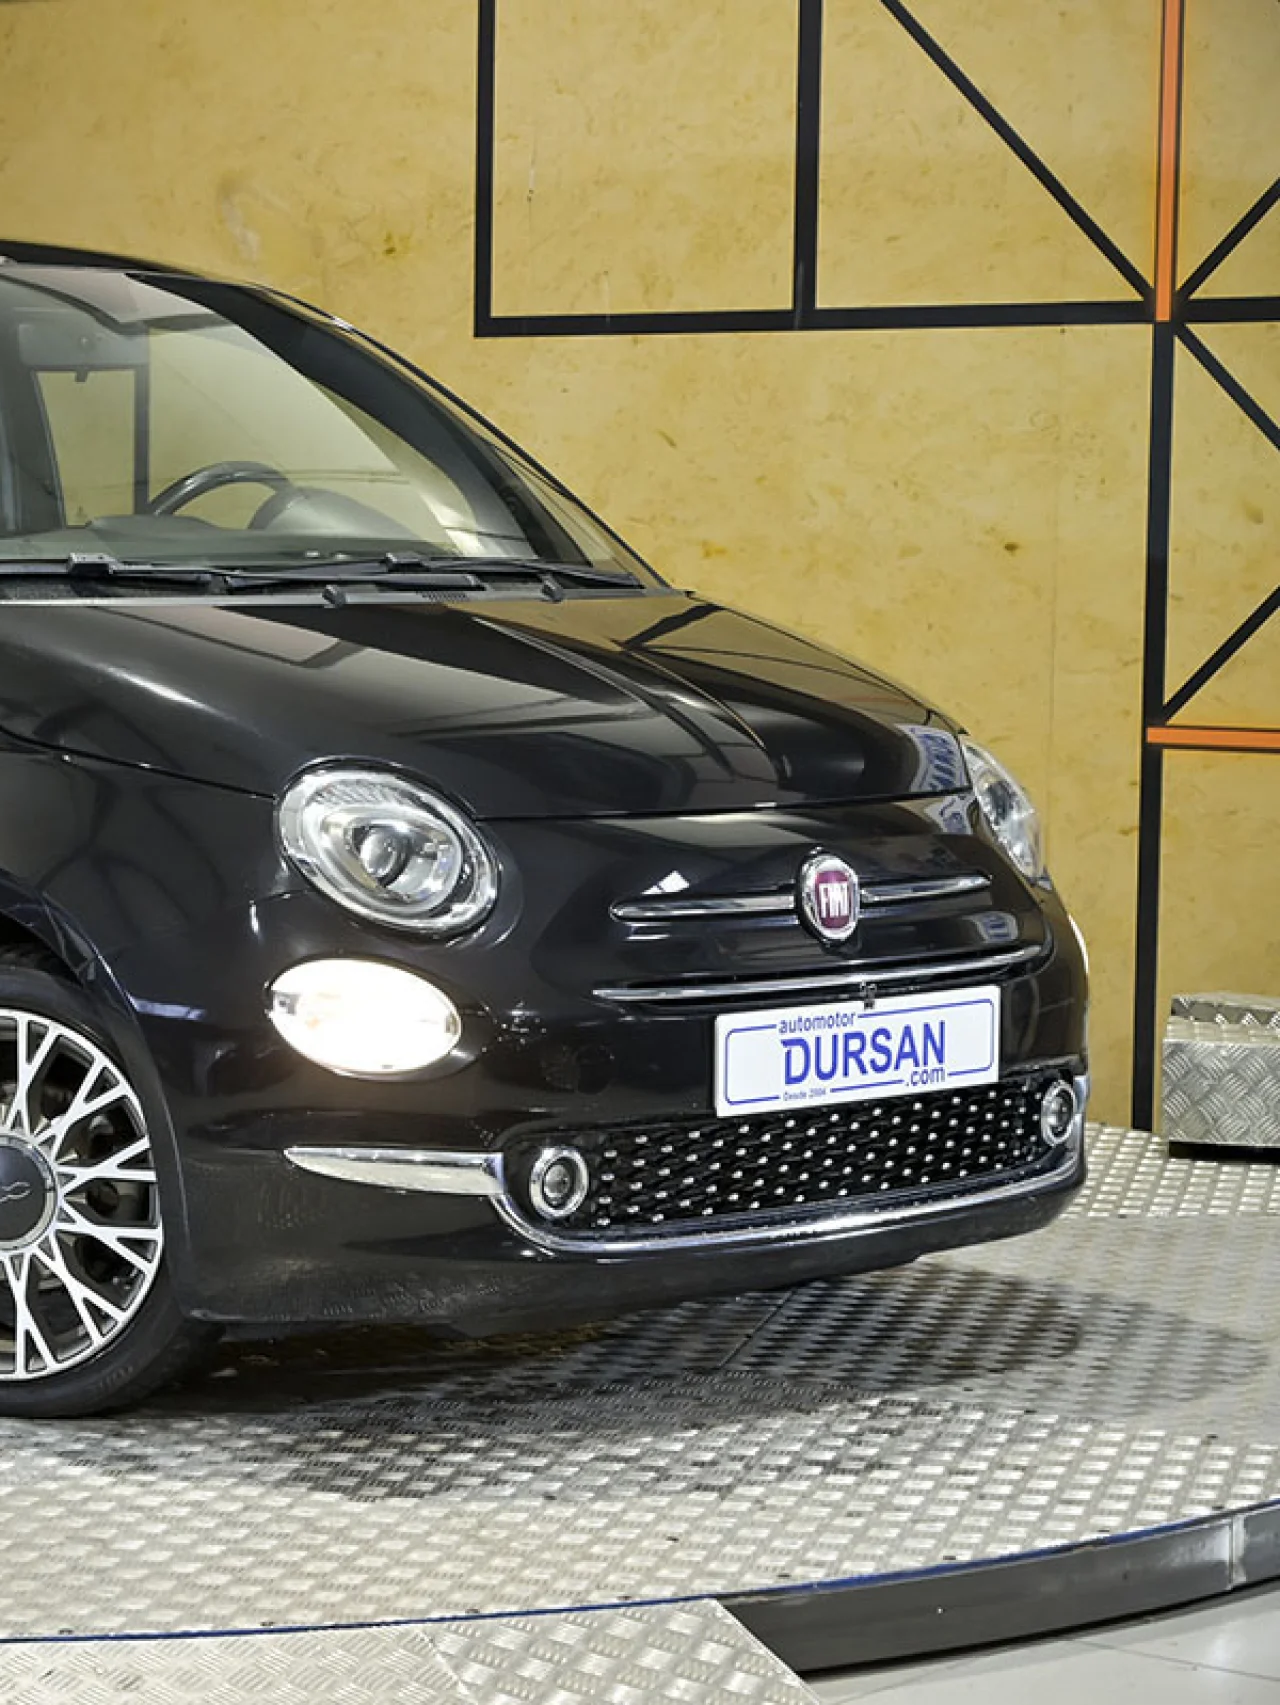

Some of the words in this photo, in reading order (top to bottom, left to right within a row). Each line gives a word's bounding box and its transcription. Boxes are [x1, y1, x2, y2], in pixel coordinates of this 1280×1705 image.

[778, 1012, 856, 1034] automotor
[780, 1020, 945, 1085] DURSAN
[905, 1066, 946, 1087] .com
